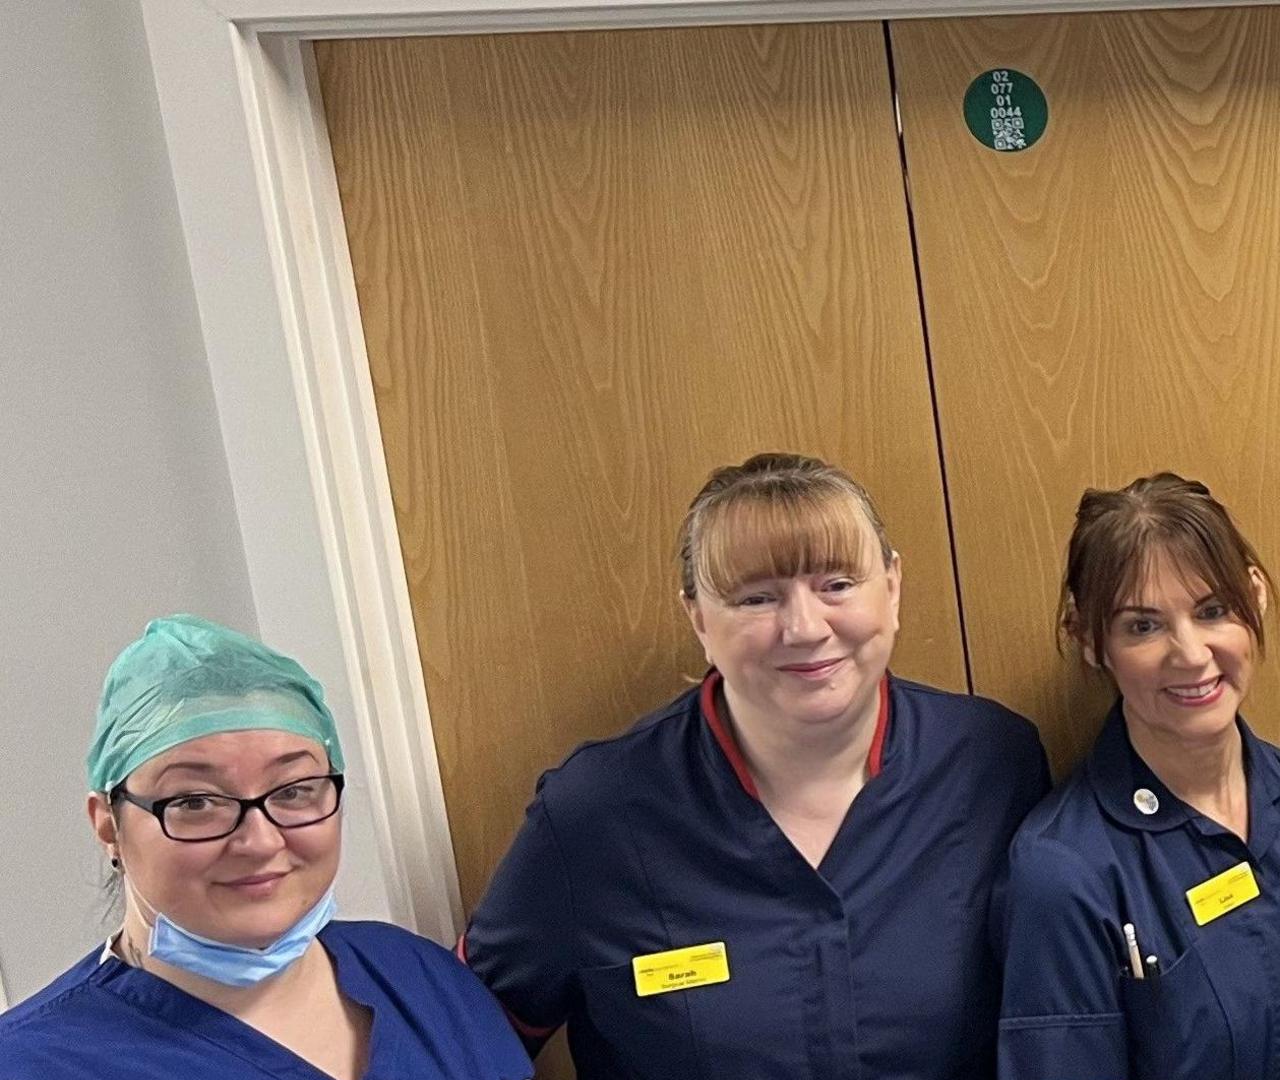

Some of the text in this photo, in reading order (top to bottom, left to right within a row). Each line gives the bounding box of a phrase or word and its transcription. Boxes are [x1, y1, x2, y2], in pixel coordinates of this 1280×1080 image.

[992, 70, 1009, 82] 02
[990, 82, 1013, 95] 077
[996, 94, 1012, 106] 01
[990, 106, 1022, 119] 0044
